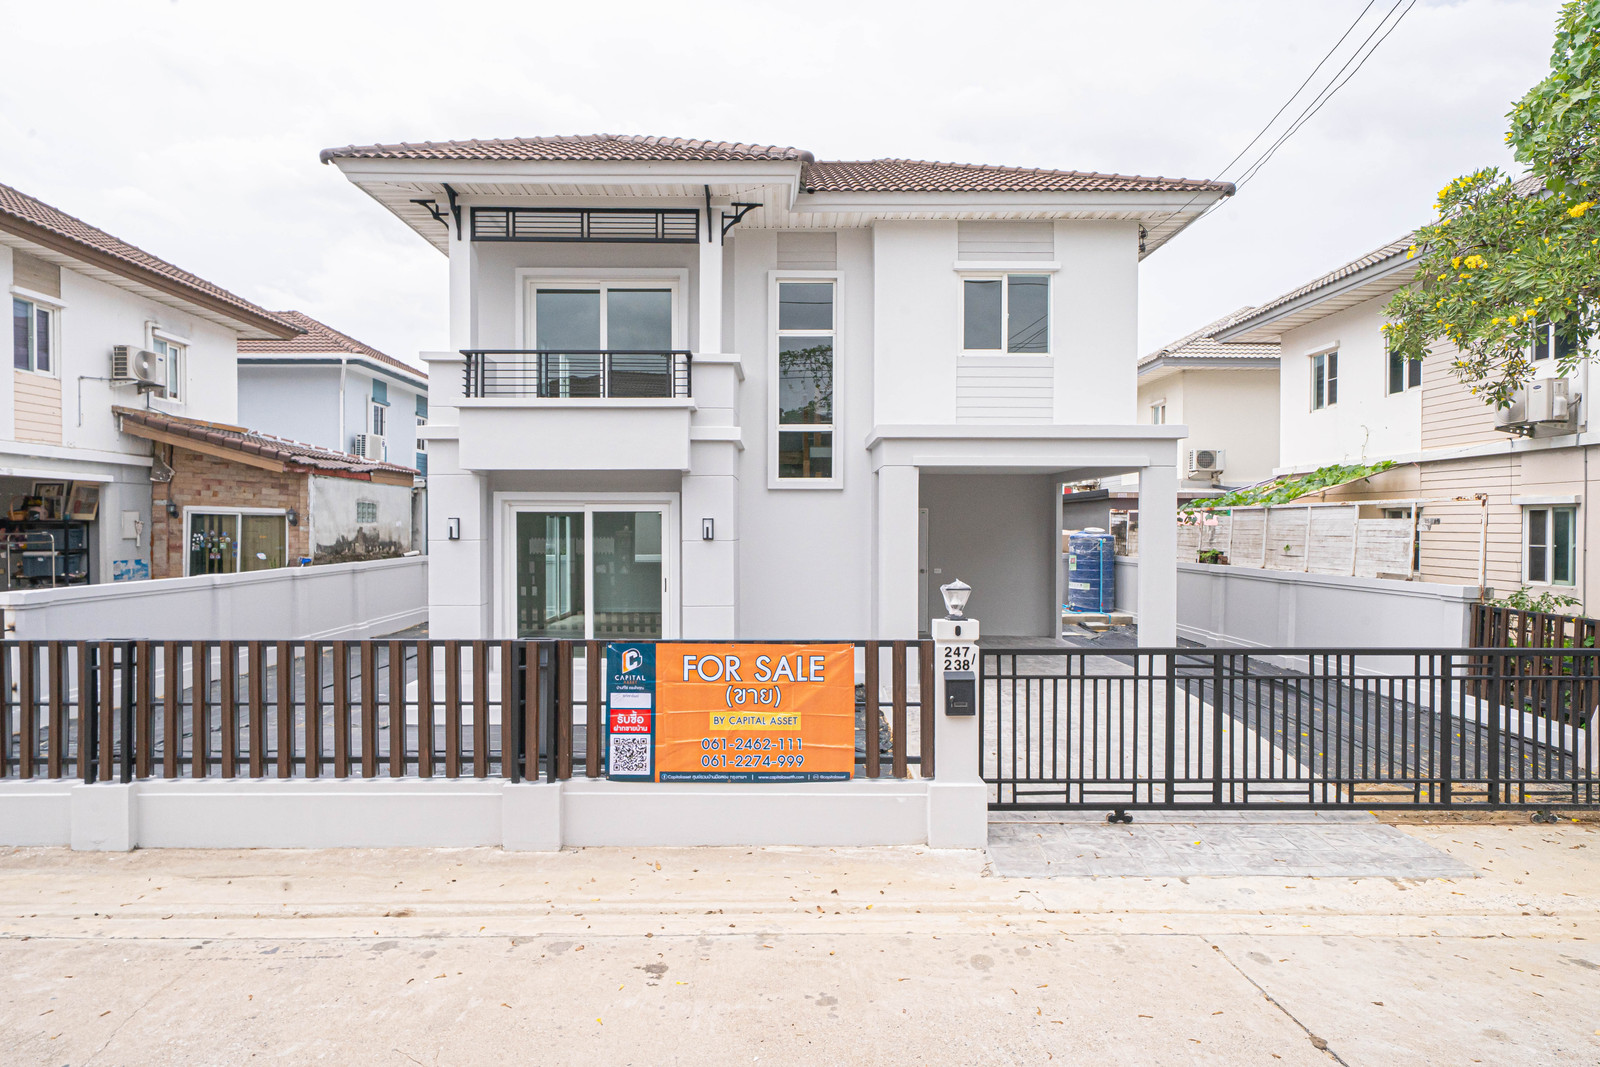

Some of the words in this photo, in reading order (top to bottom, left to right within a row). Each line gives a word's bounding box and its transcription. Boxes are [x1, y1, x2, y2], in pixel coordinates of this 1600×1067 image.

[683, 655, 742, 682] FOR
[754, 655, 825, 682] SALE
[726, 685, 781, 708] (ขาย)
[617, 710, 644, 724] รับซื้อ
[713, 716, 725, 725] BY
[729, 716, 766, 725] CAPITAL
[770, 716, 798, 725] ASSET
[701, 738, 803, 751] 061-2462-111
[701, 755, 805, 768] 061-2274-999
